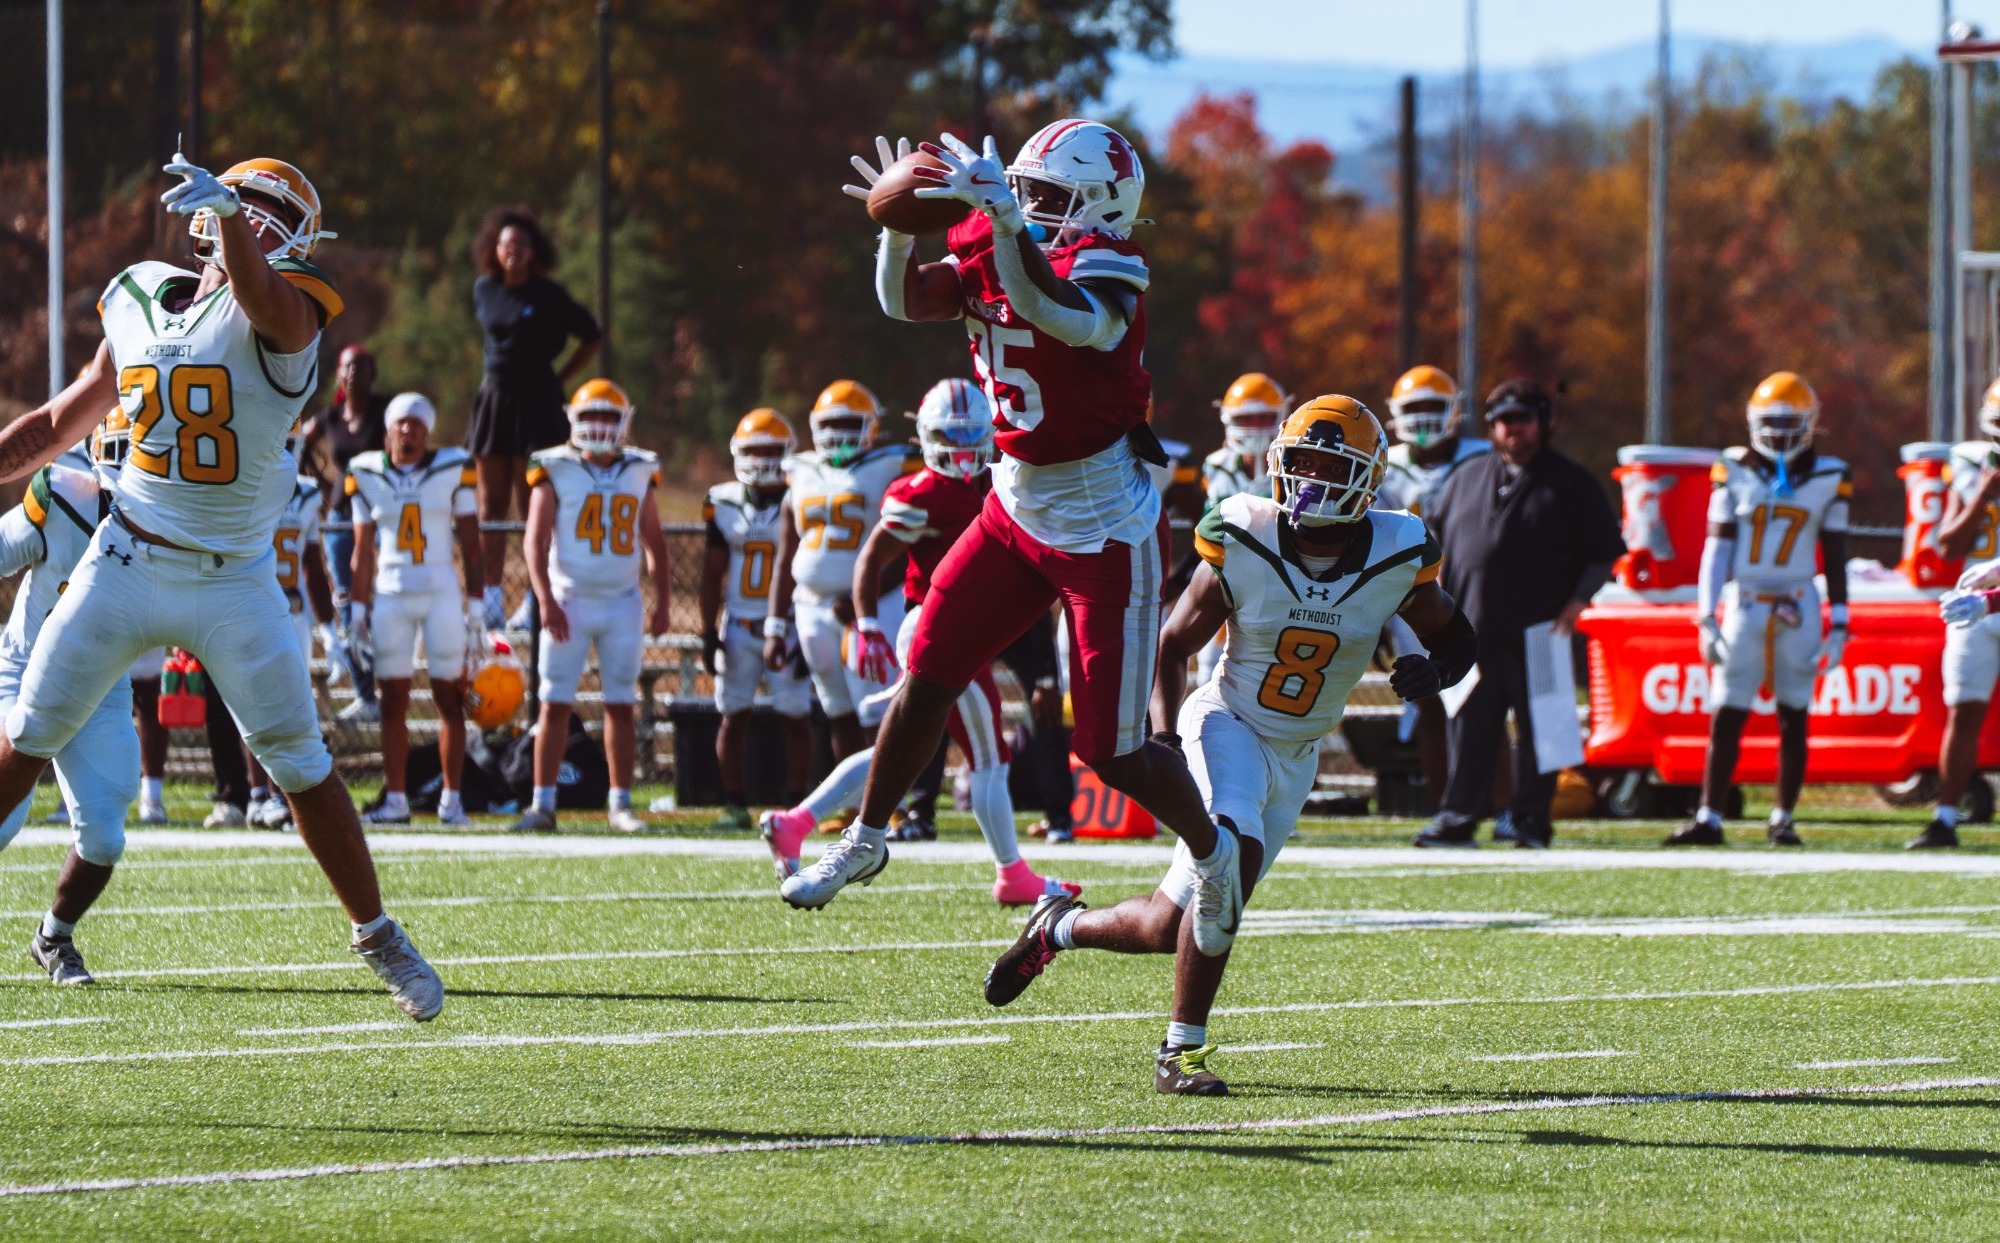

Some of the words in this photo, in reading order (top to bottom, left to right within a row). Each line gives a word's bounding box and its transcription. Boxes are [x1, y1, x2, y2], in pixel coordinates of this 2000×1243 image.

[144, 344, 193, 357] METHODIST
[119, 364, 239, 485] 28
[396, 501, 427, 566] 4
[575, 492, 639, 556] 48
[799, 491, 867, 552] 55
[1749, 503, 1810, 567] 17
[741, 540, 776, 599] 0
[1288, 608, 1342, 626] METHODIST
[1257, 626, 1340, 717] 8
[1641, 662, 1922, 716] GAADE
